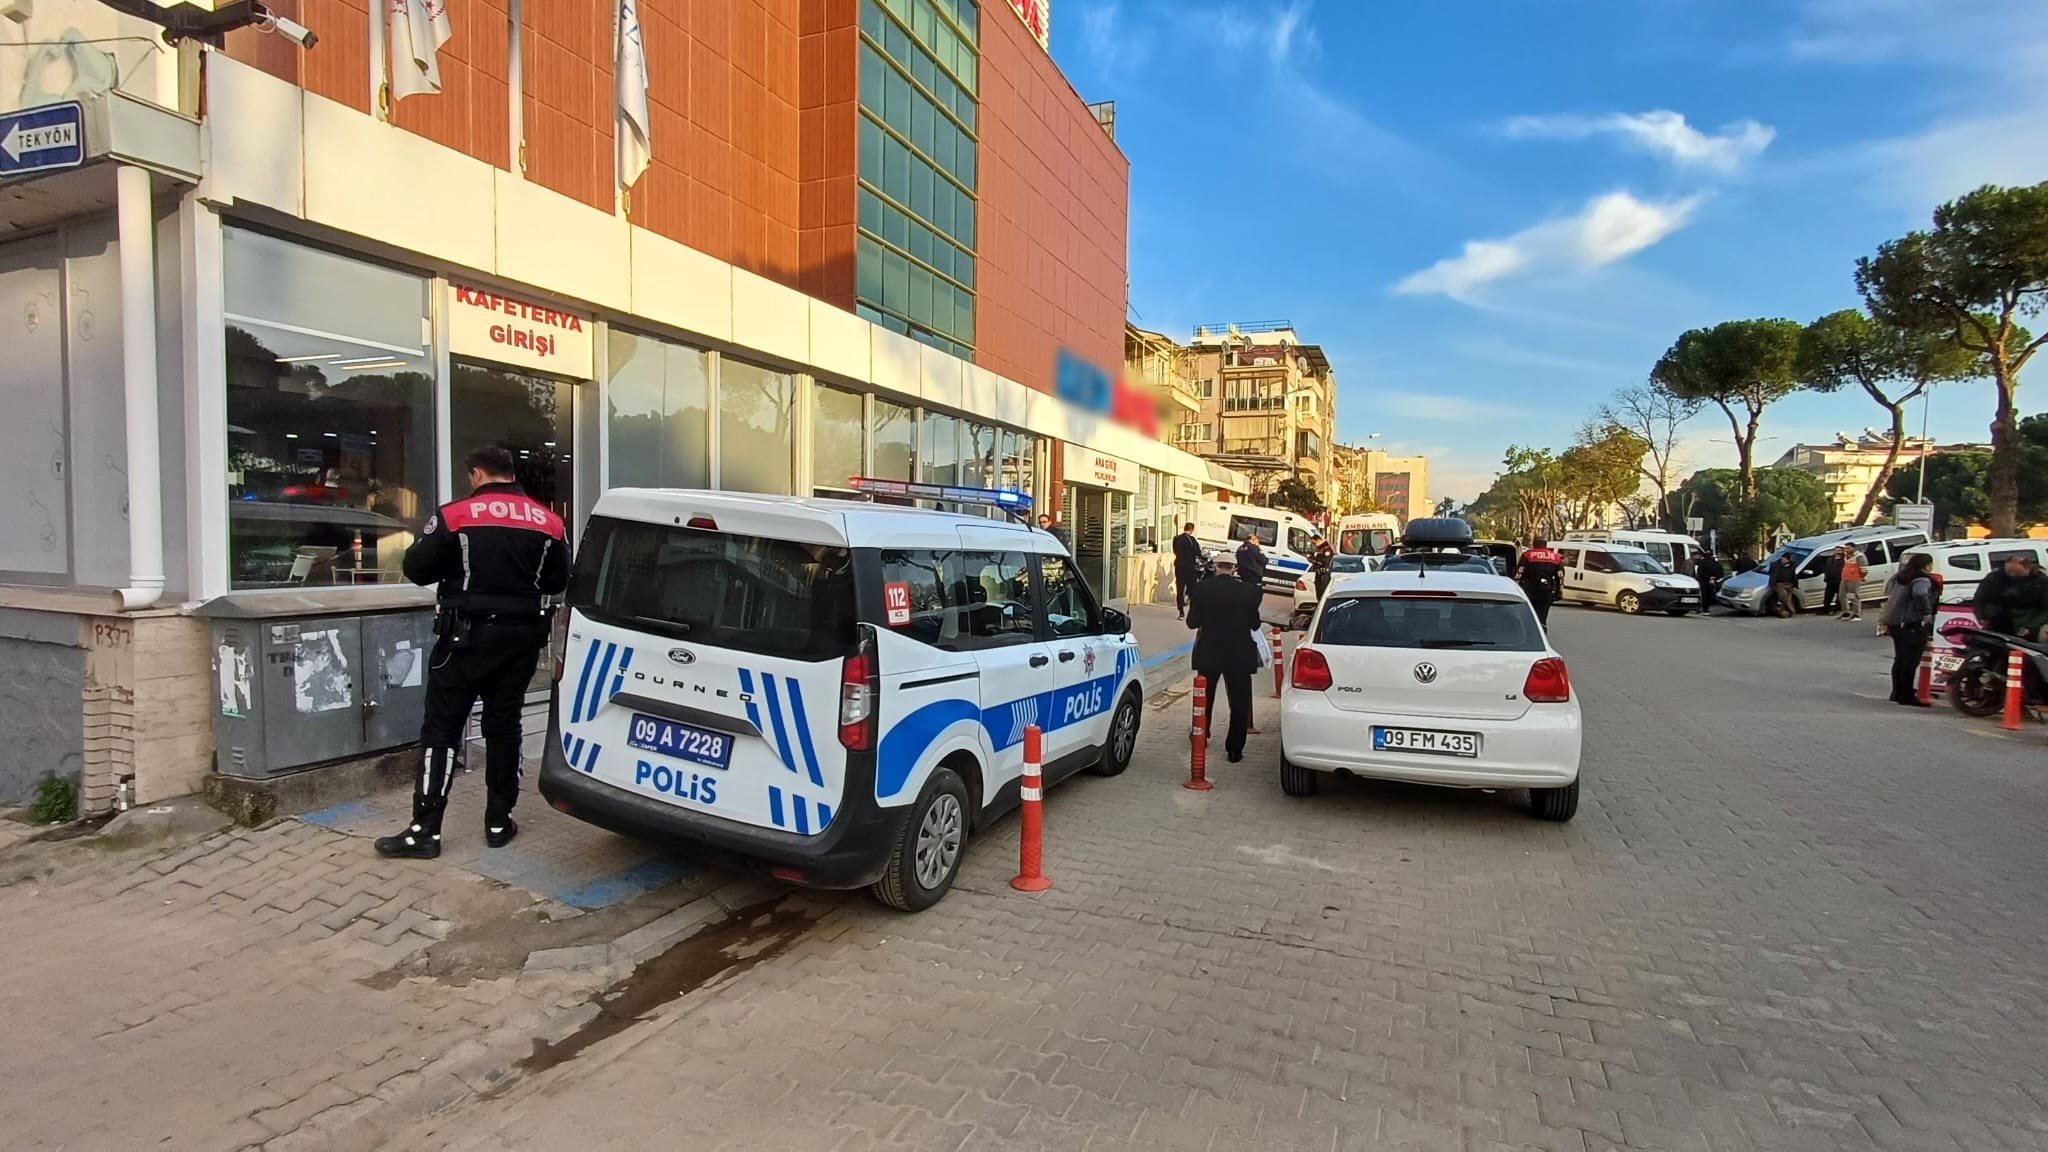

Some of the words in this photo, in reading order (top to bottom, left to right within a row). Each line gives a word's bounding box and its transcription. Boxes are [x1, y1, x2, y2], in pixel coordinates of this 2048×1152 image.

[19, 133, 41, 149] TEK
[45, 127, 71, 145] YÖN
[456, 284, 583, 333] KAFETERYA
[489, 324, 555, 357] GİRİŞİ
[1344, 522, 1388, 530] AMBULANS
[888, 587, 906, 608] 112
[618, 667, 752, 702] TOURNEO
[1063, 681, 1102, 724] POLİS
[635, 719, 657, 743] 09
[659, 725, 673, 748] A
[679, 729, 723, 759] 7228
[1384, 730, 1404, 745] 09
[1410, 733, 1434, 748] FM
[1440, 735, 1473, 751] 435
